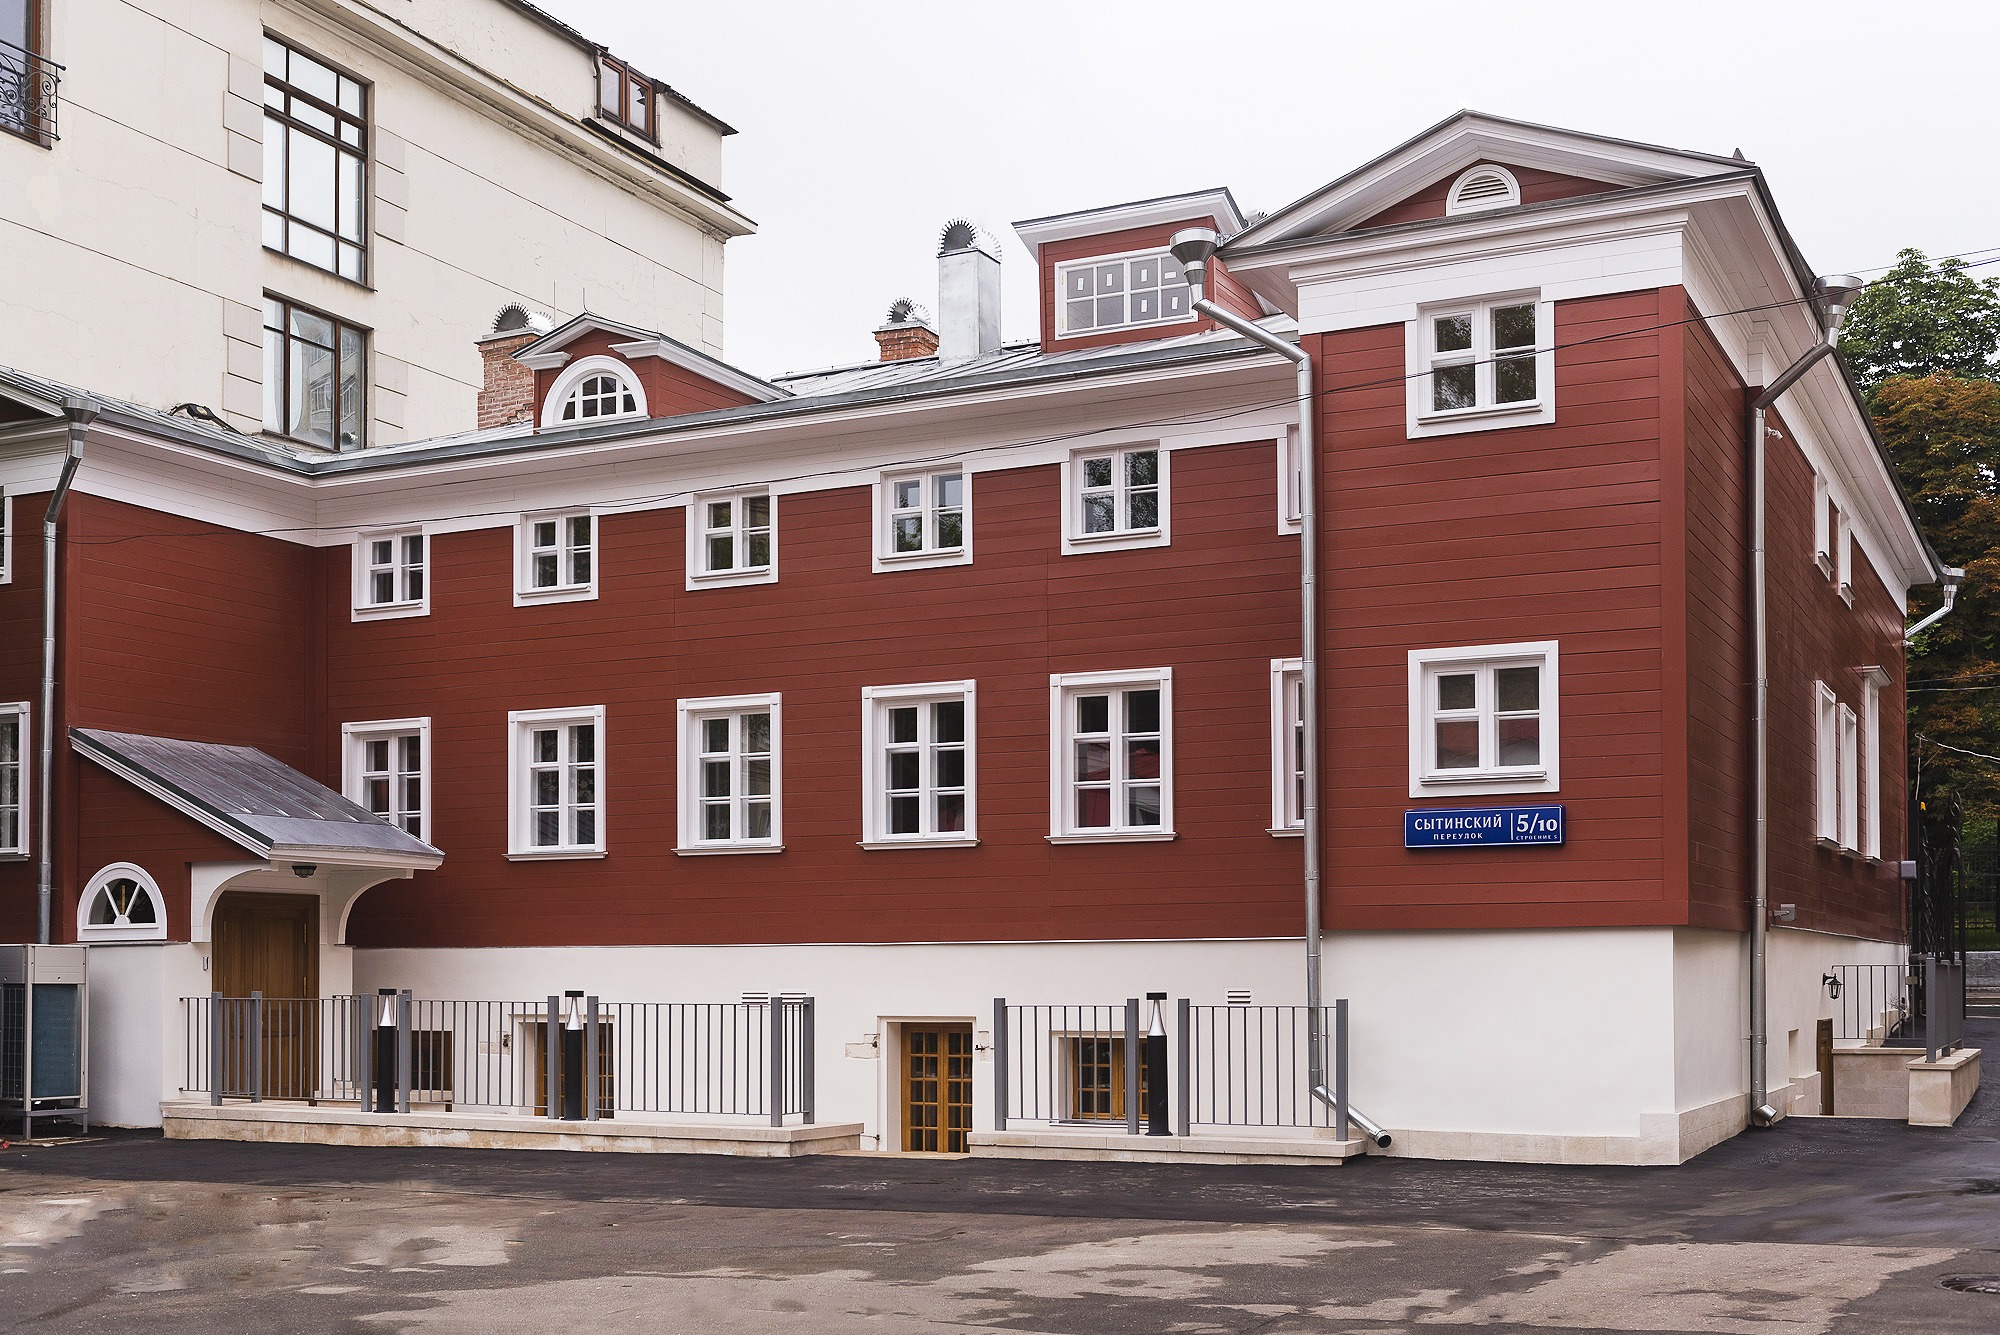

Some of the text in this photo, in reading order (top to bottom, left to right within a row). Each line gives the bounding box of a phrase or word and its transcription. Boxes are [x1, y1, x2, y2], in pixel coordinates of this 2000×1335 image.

[1414, 814, 1502, 830] СЫТИНСКИЙ
[1516, 813, 1558, 834] 5/10
[1433, 832, 1483, 840] ПЕРЕУЛОК
